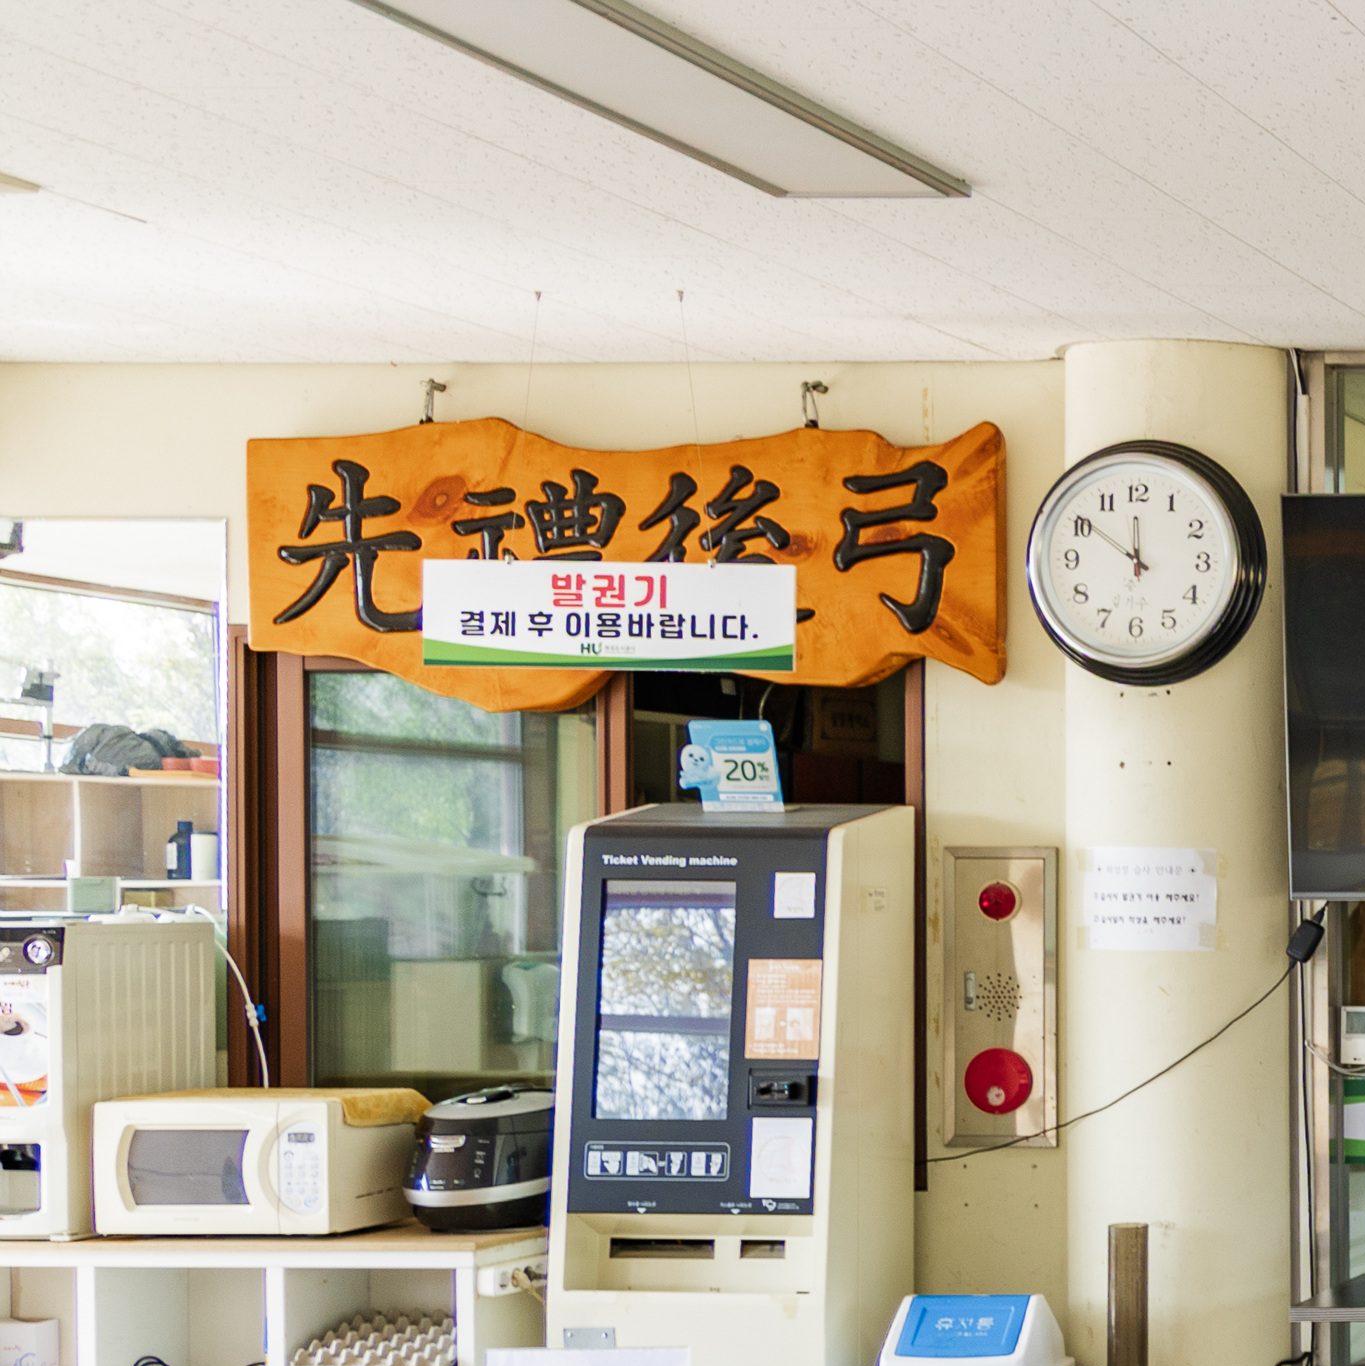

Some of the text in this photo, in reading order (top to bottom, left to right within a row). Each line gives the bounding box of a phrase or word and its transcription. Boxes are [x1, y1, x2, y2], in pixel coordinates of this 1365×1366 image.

[1099, 493, 1115, 512] 11
[1128, 483, 1149, 502] 12
[1168, 493, 1176, 512] 1
[1073, 516, 1092, 537] 10
[1187, 519, 1204, 539] 2
[1064, 549, 1080, 570] 9
[1195, 552, 1211, 573] 3
[551, 573, 668, 609] 발권기
[1072, 583, 1089, 604] 8
[1182, 584, 1199, 605] 4
[460, 610, 516, 637] 결제
[527, 611, 554, 638] 후
[1097, 608, 1112, 628] 7
[1128, 617, 1144, 638] 6
[1161, 609, 1176, 629] 5
[602, 854, 738, 868] Ticket Vending machine
